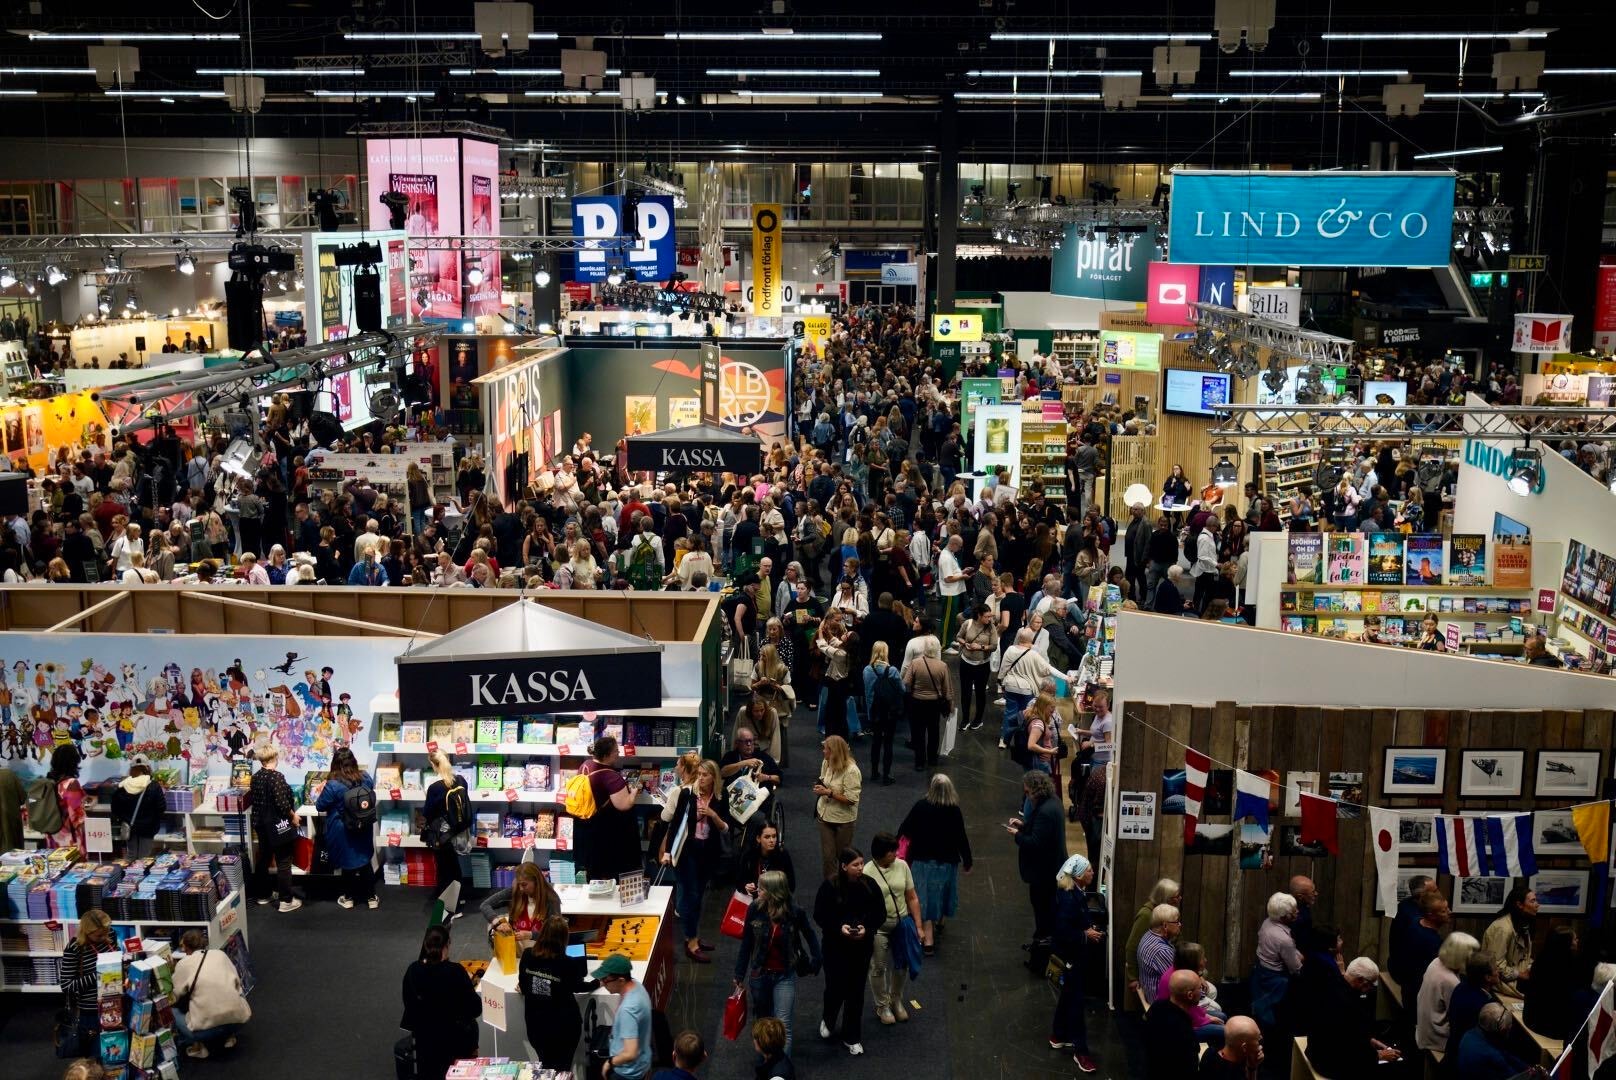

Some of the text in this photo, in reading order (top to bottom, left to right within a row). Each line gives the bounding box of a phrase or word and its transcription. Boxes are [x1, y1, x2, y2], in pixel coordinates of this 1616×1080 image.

[392, 181, 435, 195] WENNSTAM
[1194, 198, 1428, 239] LIND & CO
[762, 236, 773, 310] Ordfront förlag
[1252, 294, 1288, 315] gilla
[1384, 328, 1404, 337] FOOD
[1391, 333, 1420, 342] DRINKS
[662, 448, 726, 467] KASSA
[1290, 537, 1320, 545] DRÖMMEN
[1297, 552, 1313, 560] RÖST
[469, 668, 597, 706] KASSA
[88, 830, 110, 839] 149:-
[484, 996, 504, 1010] 149:-
